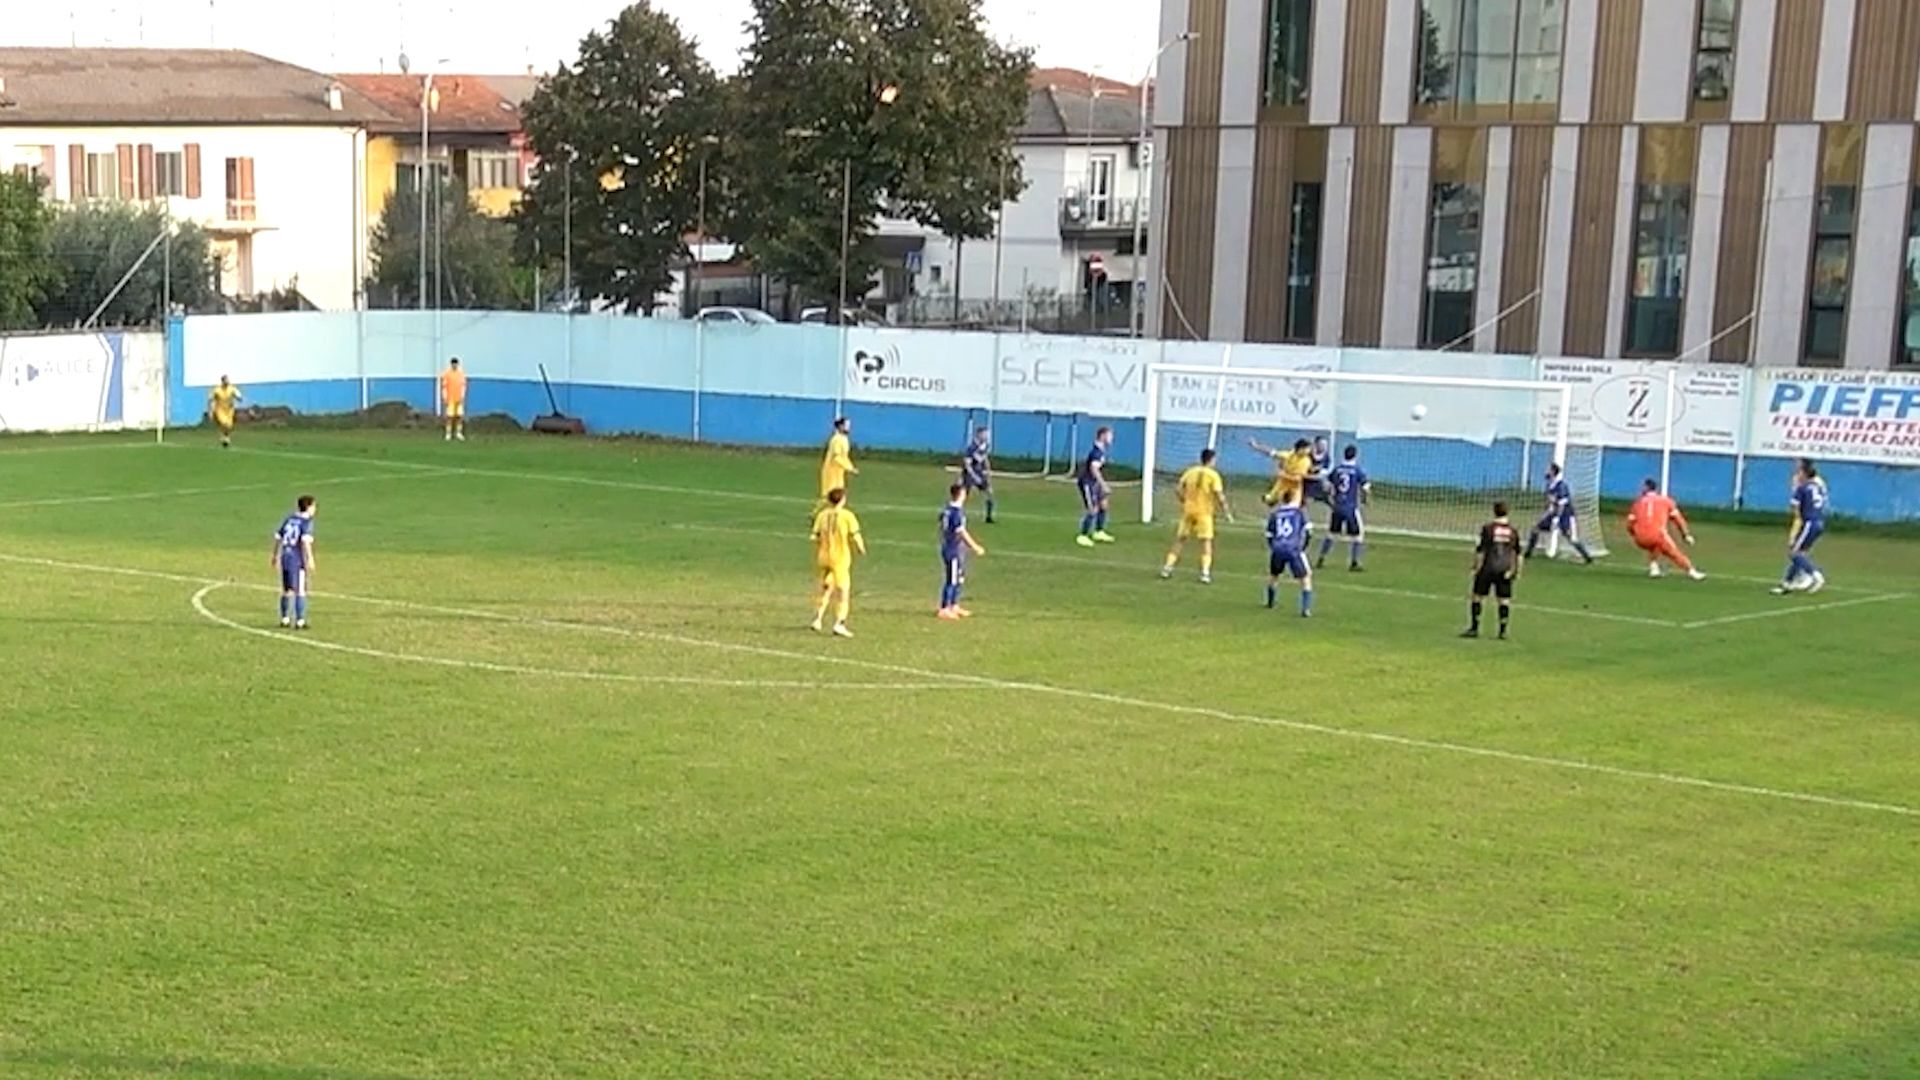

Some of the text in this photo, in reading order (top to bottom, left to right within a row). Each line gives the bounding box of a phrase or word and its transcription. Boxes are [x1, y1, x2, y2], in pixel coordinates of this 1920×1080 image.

[877, 375, 946, 393] CIRCUS
[1171, 376, 1202, 391] SAN
[1338, 472, 1351, 493] 3
[282, 523, 300, 545] 20
[1276, 516, 1294, 538] 16
